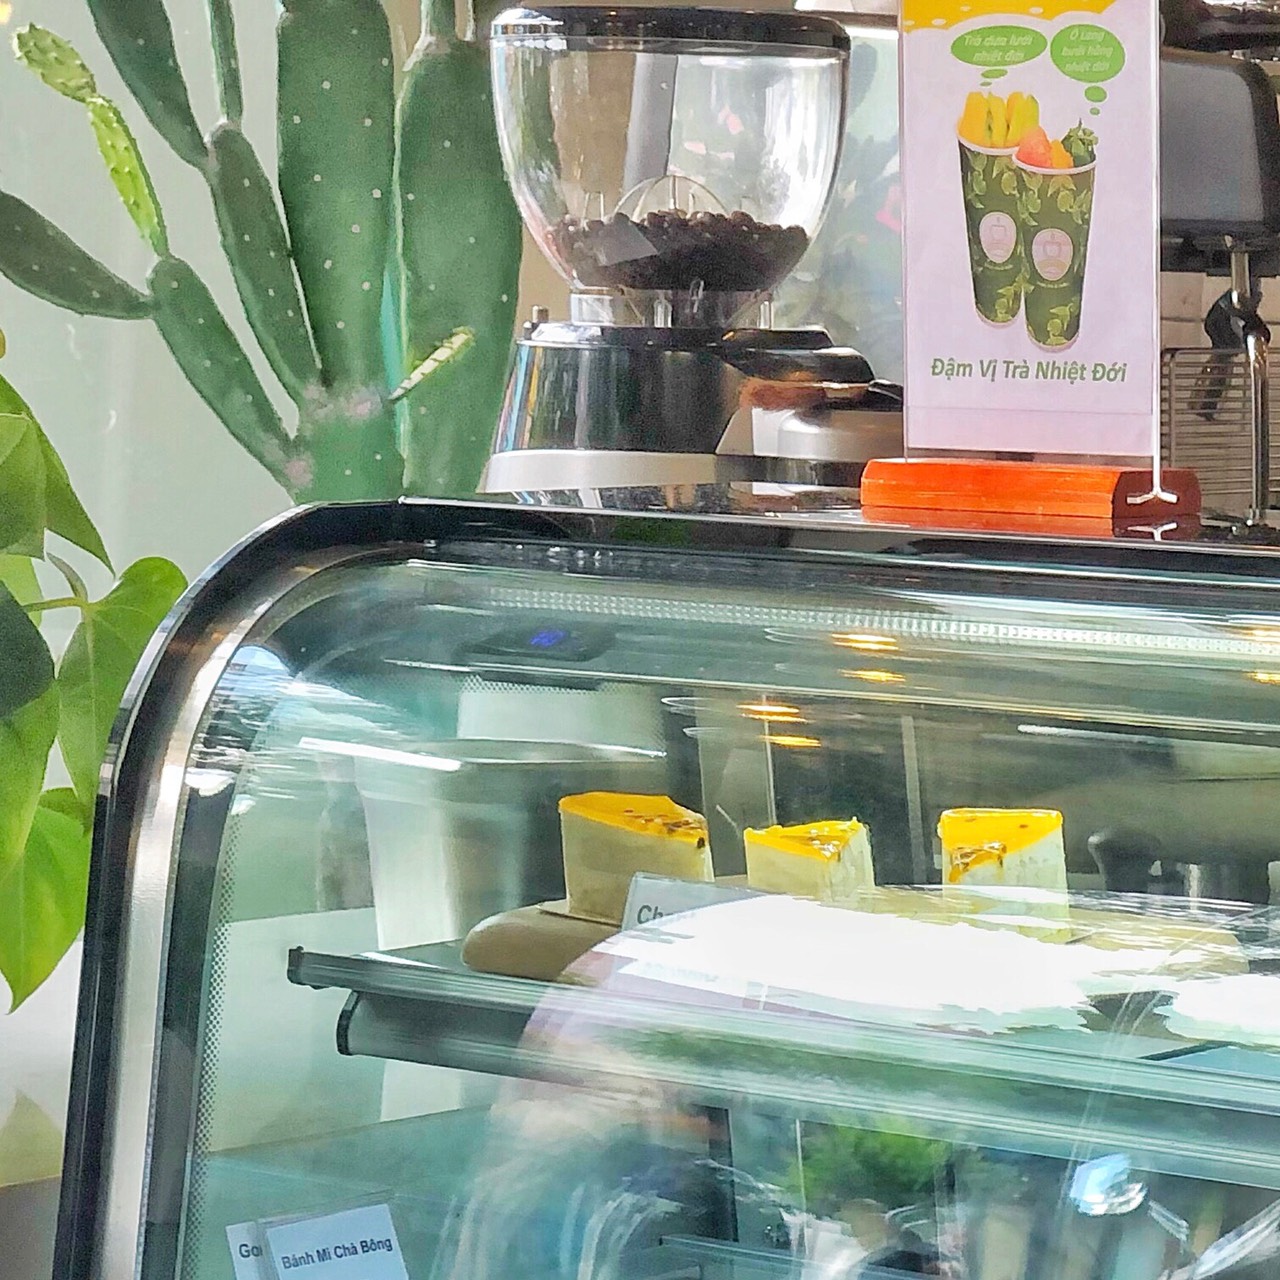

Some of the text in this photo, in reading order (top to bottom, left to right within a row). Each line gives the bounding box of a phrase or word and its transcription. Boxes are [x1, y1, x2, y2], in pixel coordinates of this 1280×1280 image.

[931, 357, 1127, 384] Đậm Vị Trà Nhiệt Đới
[282, 1252, 315, 1269] Bánh
[359, 1239, 393, 1254] Bông
